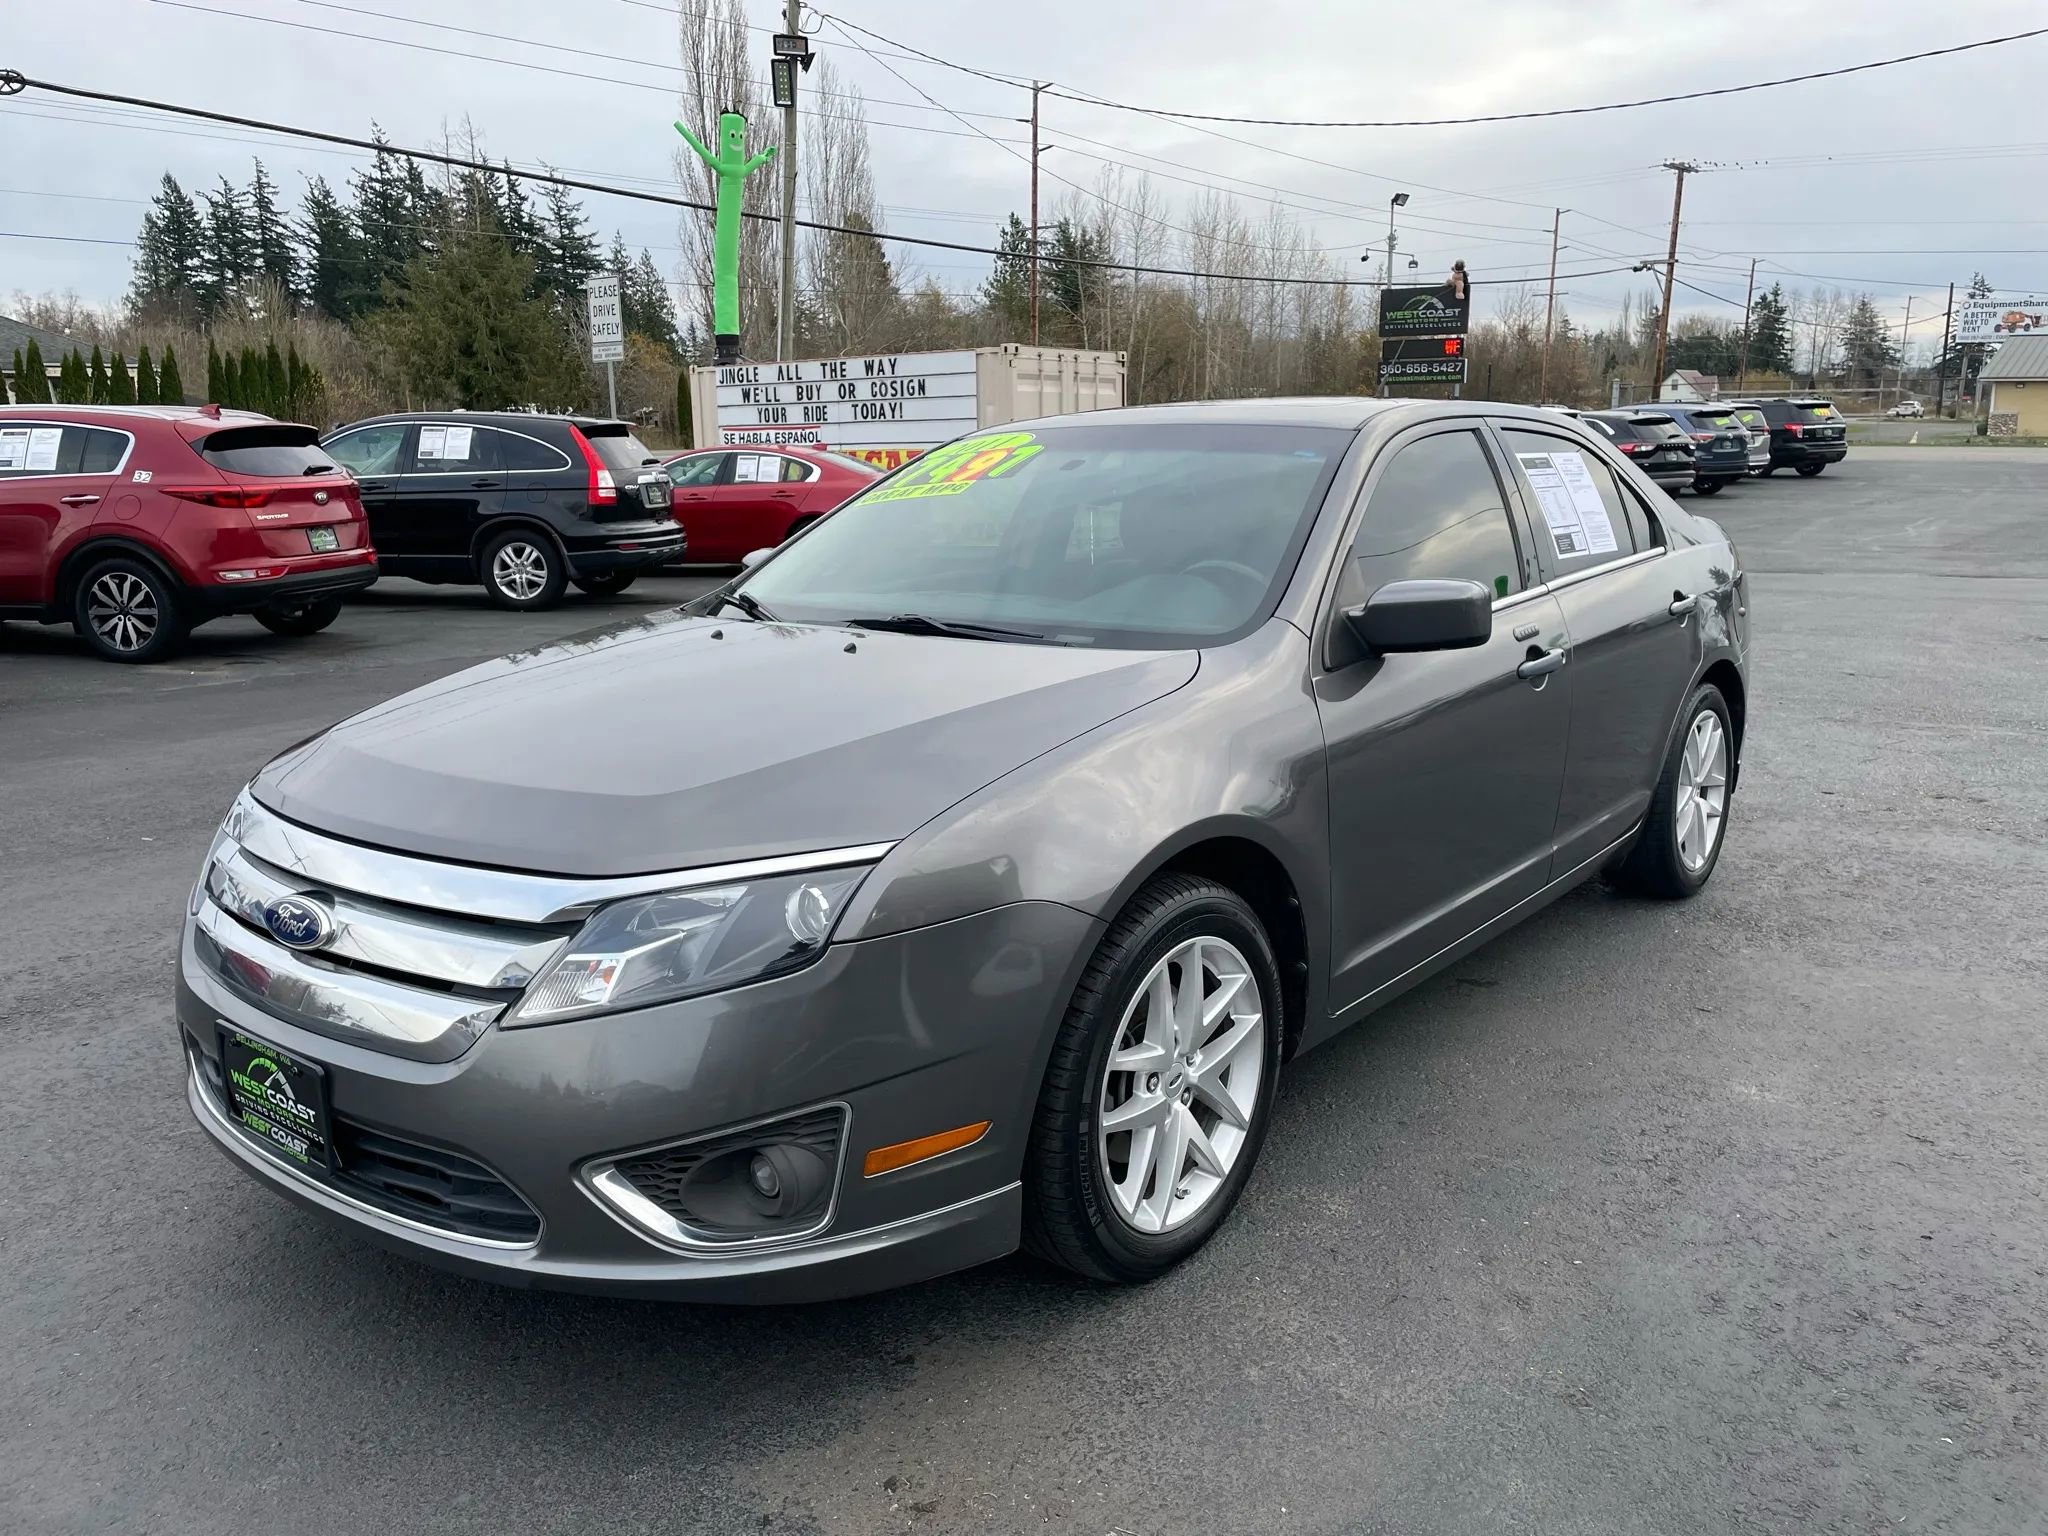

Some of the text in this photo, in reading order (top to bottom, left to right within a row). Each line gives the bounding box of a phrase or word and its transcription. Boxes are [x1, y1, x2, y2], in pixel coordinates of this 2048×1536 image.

[589, 284, 618, 299] PLEASE
[592, 304, 617, 318] DRIVE
[1386, 308, 1462, 320] WESTCOAST
[1970, 311, 1998, 319] BETTER
[592, 322, 620, 337] SAFELY
[1962, 325, 1981, 333] RENT
[719, 358, 897, 385] JINGLE ALL THE WAY
[741, 378, 926, 404] WE'LL BUY OR COSIGN
[757, 401, 903, 424] YOUR RIDE TODAY!
[723, 432, 736, 445] SE
[738, 431, 772, 444] HABLA
[134, 471, 151, 482] 32
[272, 903, 310, 938] Ford
[279, 1052, 292, 1066] WA
[230, 1068, 317, 1124] WESTCOAST
[257, 1098, 295, 1121] MOTORS
[234, 1093, 325, 1145] DRIVING EXCELLENCE
[283, 1144, 309, 1164] MOTORS
